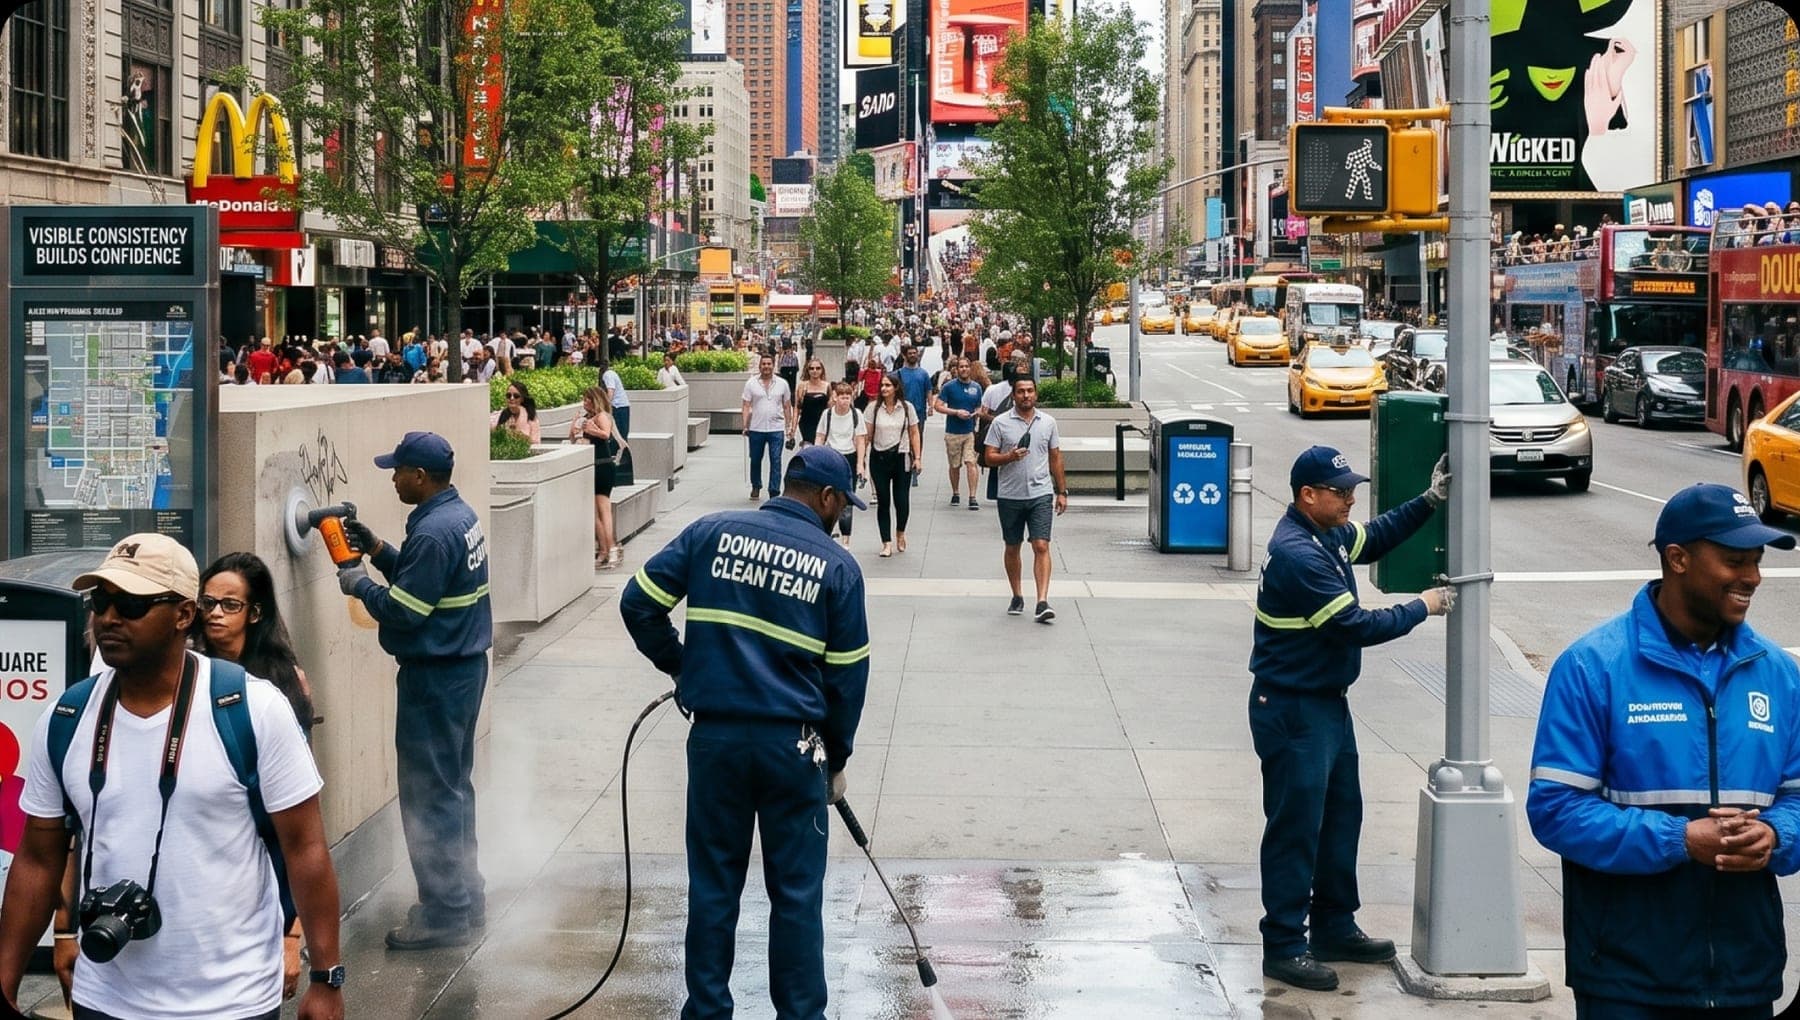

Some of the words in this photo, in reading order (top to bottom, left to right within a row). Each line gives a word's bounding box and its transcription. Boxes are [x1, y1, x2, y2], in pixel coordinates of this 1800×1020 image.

[29, 227, 85, 244] VISIBLE
[88, 227, 188, 244] CONSISTENCY
[36, 247, 88, 265] BUILDS
[91, 247, 182, 265] CONFIDENCE
[717, 532, 828, 579] DOWNTOWN
[711, 556, 768, 588] CLEAN
[770, 569, 821, 604] TEAM
